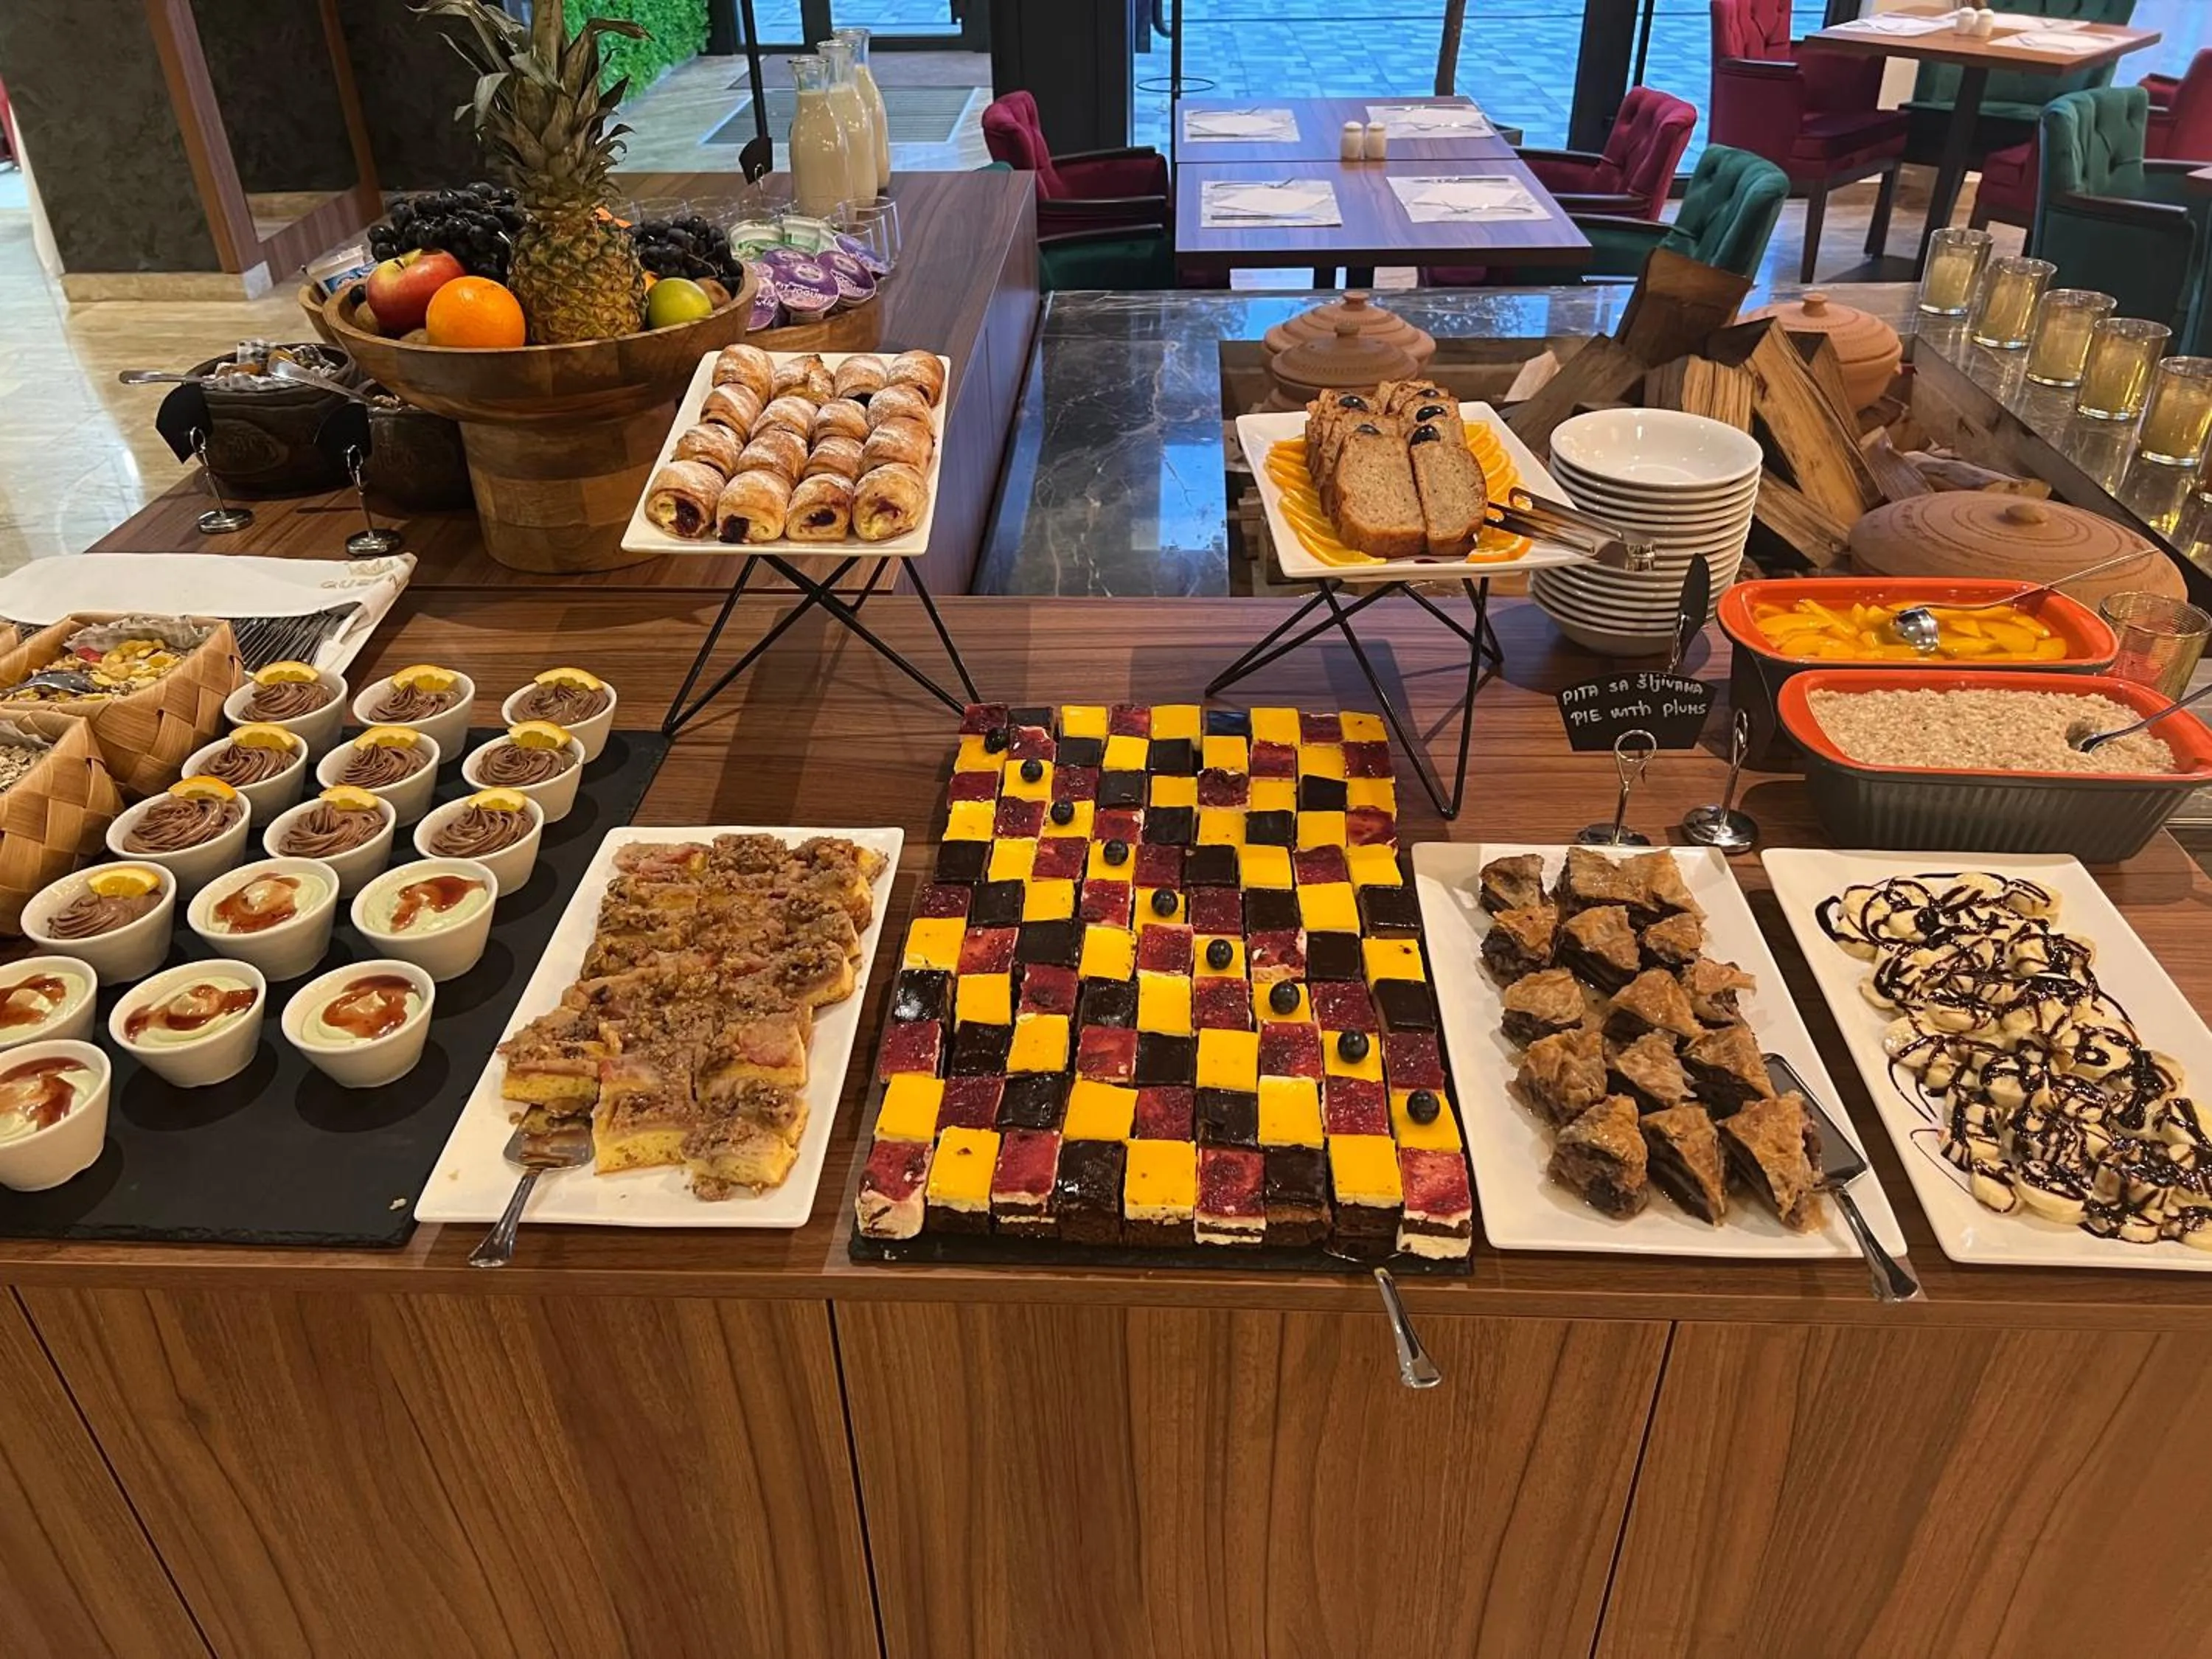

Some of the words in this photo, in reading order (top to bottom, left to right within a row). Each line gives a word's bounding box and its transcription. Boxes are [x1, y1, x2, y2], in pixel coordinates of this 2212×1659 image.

[1562, 684, 1599, 706] PITA
[1609, 679, 1629, 691] SA
[1571, 709, 1603, 726] PIE
